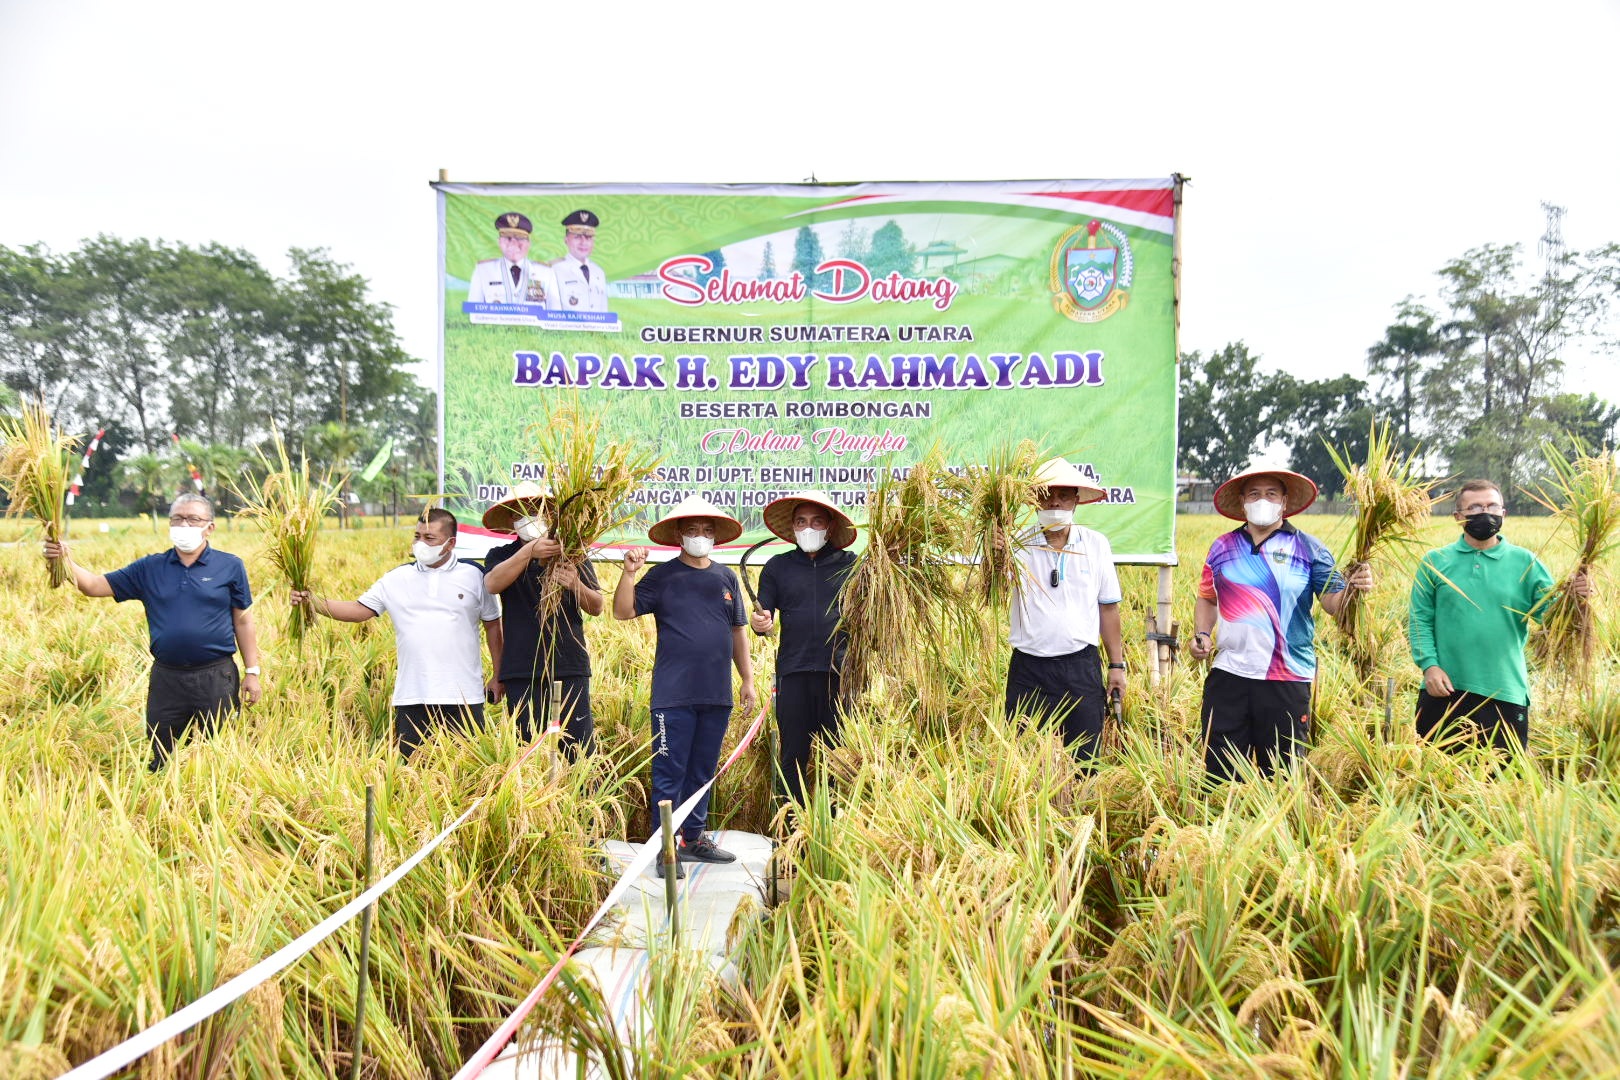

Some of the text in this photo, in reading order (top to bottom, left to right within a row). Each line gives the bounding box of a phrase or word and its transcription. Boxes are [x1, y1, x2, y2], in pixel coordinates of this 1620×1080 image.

[660, 257, 957, 308] Selamat Datang
[641, 326, 973, 343] GUBERNUR SUMATERA UTARA
[514, 352, 1105, 390] BAPAK H. EDY RAHMAYADI
[680, 402, 931, 418] BESERTA ROMBONGAN
[702, 427, 908, 461] Dalam Rangka
[695, 467, 712, 483] DI
[718, 467, 755, 483] UPT.
[760, 467, 814, 483] BENIH
[819, 467, 875, 483] INDUK
[701, 490, 737, 506] DAN
